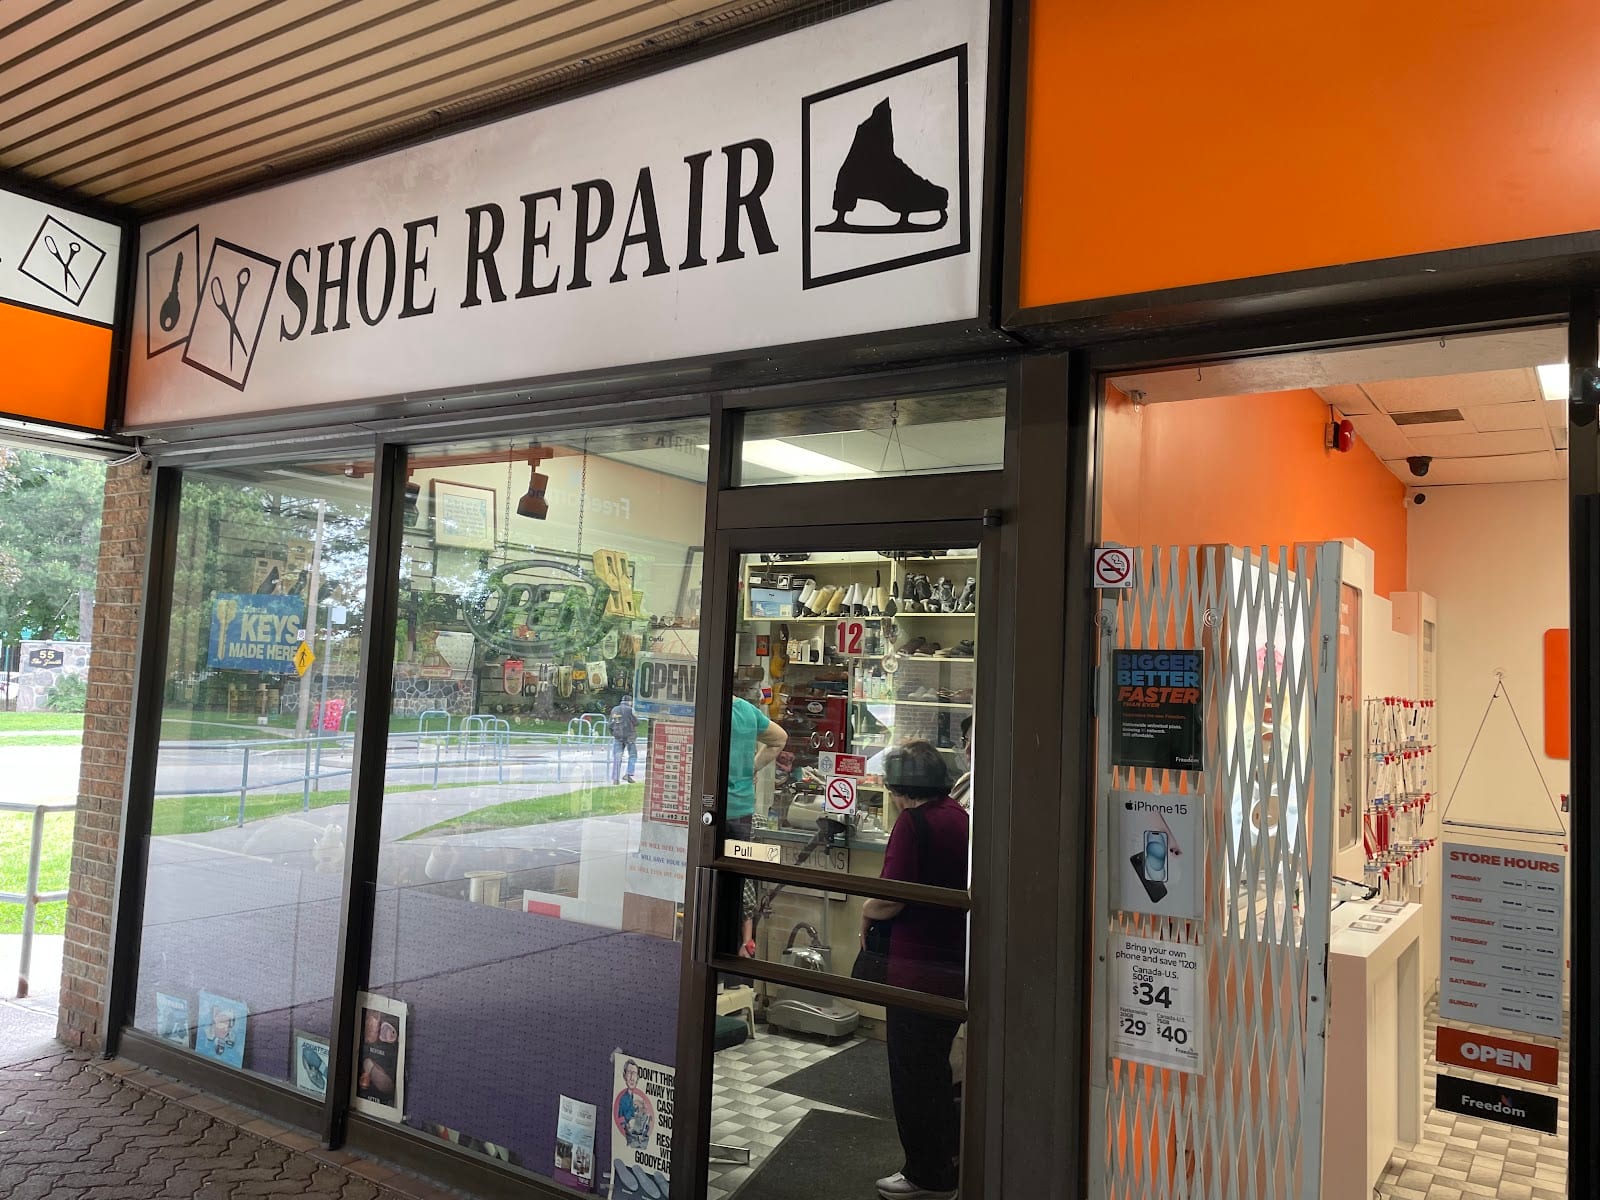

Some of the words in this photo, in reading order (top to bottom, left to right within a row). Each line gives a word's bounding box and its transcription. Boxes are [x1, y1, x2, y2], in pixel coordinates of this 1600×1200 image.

[280, 216, 438, 342] SHOE
[460, 137, 779, 309] REPAIR
[240, 614, 300, 644] KEYS
[837, 621, 863, 654] 12
[39, 650, 55, 659] 55
[229, 642, 264, 659] MADE
[266, 645, 298, 661] HERE
[1117, 654, 1199, 671] BIGGER
[640, 661, 696, 702] OPEN
[1117, 670, 1199, 688] BETTER
[1118, 686, 1200, 705] FASTER
[1134, 801, 1173, 814] iPhone
[1175, 804, 1188, 815] 15
[734, 845, 753, 857] Pull
[1450, 850, 1501, 866] STORE
[1504, 856, 1560, 873] HOURS
[1450, 874, 1482, 882] MONDAY
[1450, 894, 1482, 903] TUESDAY
[1450, 915, 1496, 926] WEDNESDAY
[1450, 935, 1488, 946] THURSDAY
[1115, 950, 1141, 960] phone
[1142, 955, 1158, 964] and
[1125, 942, 1147, 954] Bring
[1148, 946, 1167, 955] your
[1168, 950, 1186, 958] own
[1449, 956, 1475, 965] FRIDAY
[1132, 965, 1179, 980] Canada-U.S.
[1132, 973, 1154, 983] 50GB
[1449, 977, 1487, 988] SATURDAY
[1132, 982, 1172, 1009] $34
[1448, 998, 1479, 1009] SUNDAY
[1120, 1018, 1146, 1036] $29
[1156, 1026, 1188, 1045] $40
[1460, 1042, 1532, 1071] OPEN
[638, 1066, 659, 1083] DON'T
[660, 1070, 675, 1086] THR
[645, 1082, 665, 1099] AWAY
[666, 1087, 675, 1102] YO
[656, 1099, 674, 1116] CASU
[1461, 1095, 1526, 1118] Freedom
[658, 1114, 673, 1129] SHO
[656, 1133, 671, 1148] RES
[634, 1150, 671, 1174] GOODYEAR
[660, 1147, 671, 1160] WIT
